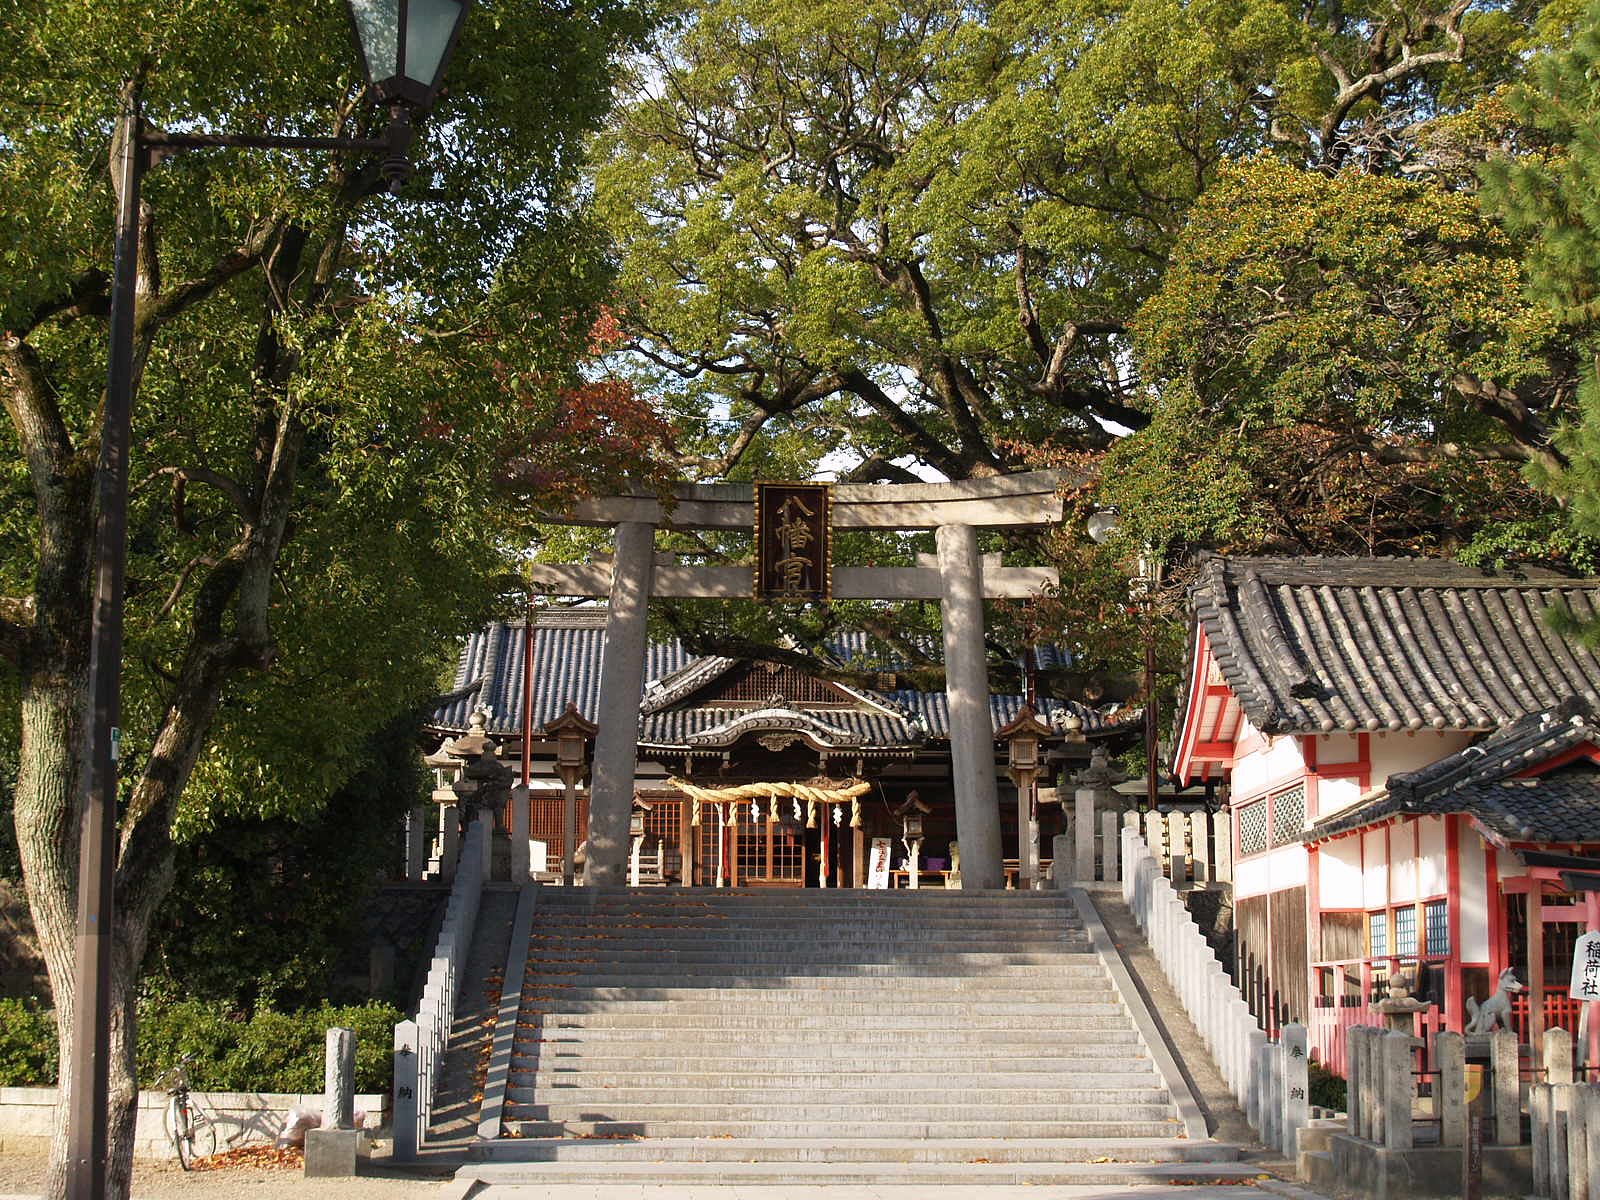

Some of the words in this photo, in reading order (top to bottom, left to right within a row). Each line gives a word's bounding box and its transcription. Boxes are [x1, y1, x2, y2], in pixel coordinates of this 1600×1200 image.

[775, 495, 816, 591] 八幡宮
[1582, 940, 1600, 997] 稲荷社
[1290, 1044, 1304, 1100] 奉納
